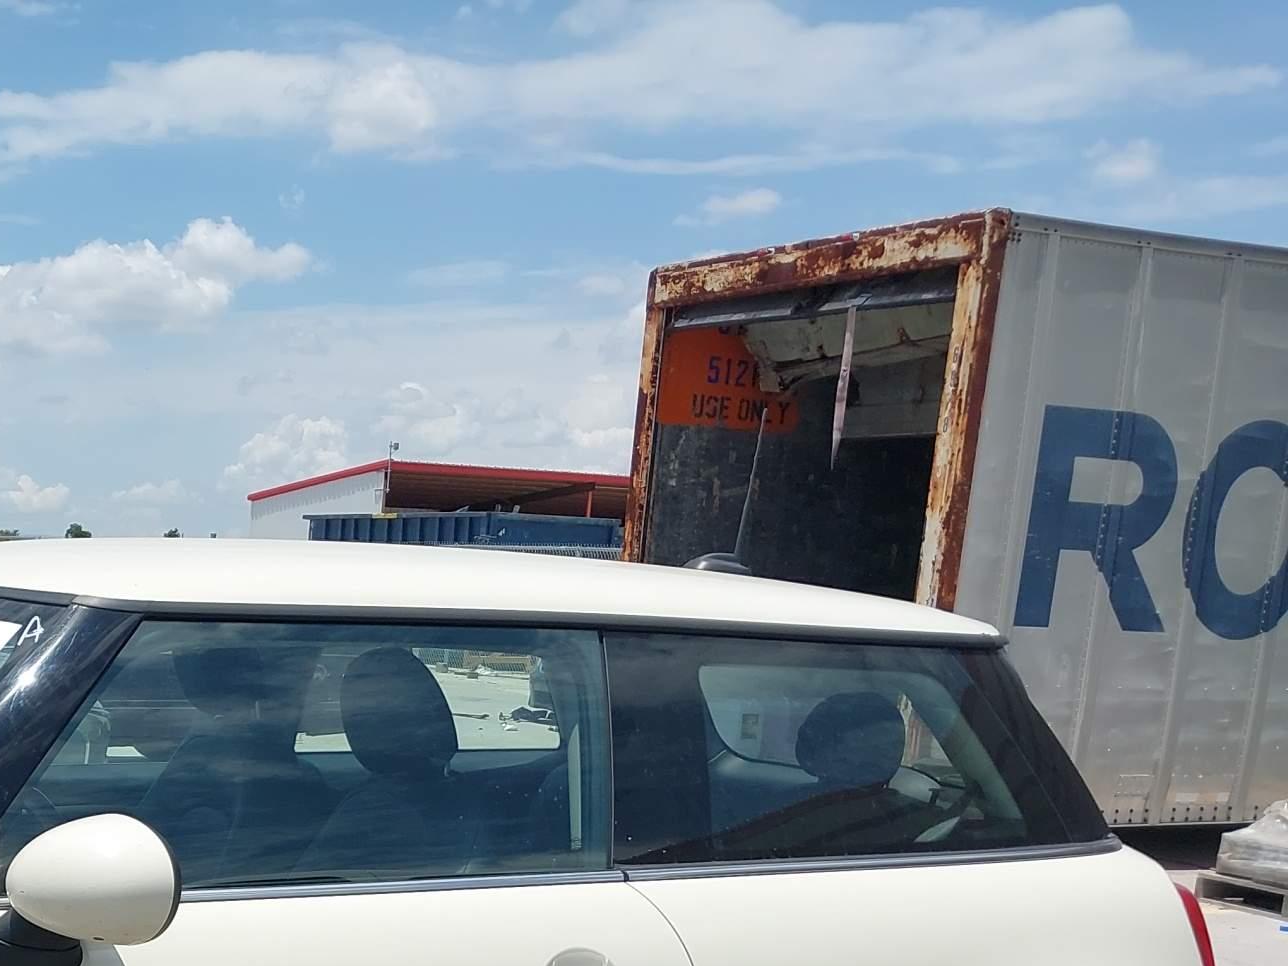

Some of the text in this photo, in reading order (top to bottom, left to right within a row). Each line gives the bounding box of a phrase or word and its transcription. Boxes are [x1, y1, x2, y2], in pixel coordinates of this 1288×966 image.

[692, 393, 790, 425] USE ONLY
[1013, 404, 1288, 640] RO
